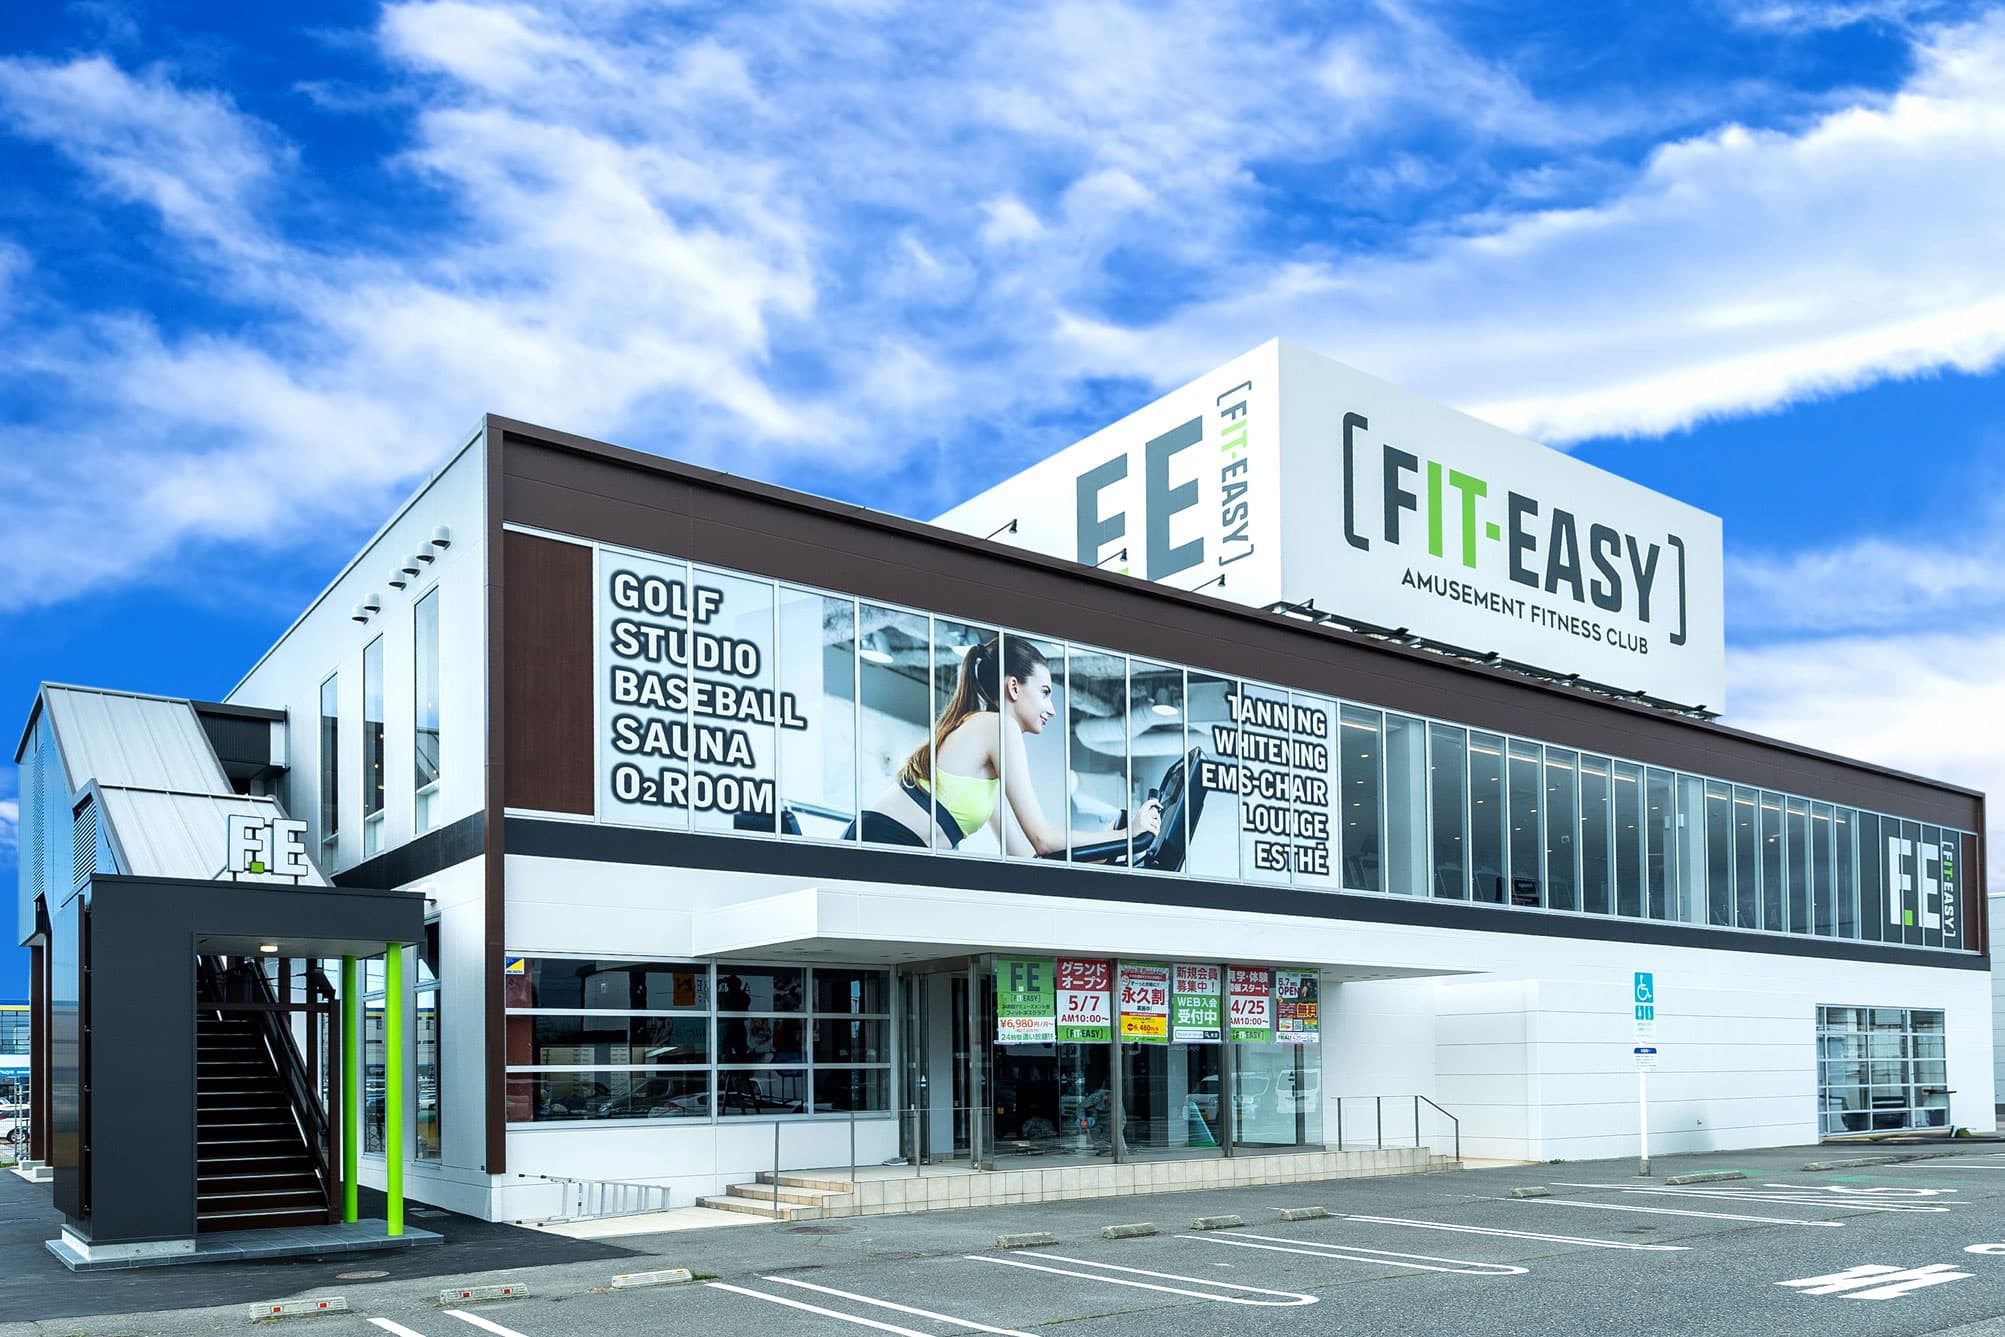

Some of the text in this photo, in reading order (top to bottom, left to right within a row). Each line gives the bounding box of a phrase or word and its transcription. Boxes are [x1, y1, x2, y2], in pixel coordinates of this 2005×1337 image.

[612, 570, 721, 622] GOLF
[1401, 568, 1650, 655] AMUSEMENT FITNESS CLUB
[612, 620, 759, 677] STUDIO
[612, 667, 806, 729] BASEBALL
[1226, 694, 1327, 738] TANNING
[613, 715, 754, 767] SAUNA
[1213, 726, 1327, 772] WHITENING
[1200, 761, 1328, 806] EMS-CHAIR
[1242, 803, 1328, 839] LOUNGE
[1061, 962, 1107, 976] グランド
[1061, 975, 1107, 989] オープン
[1176, 966, 1218, 981] 新規会員
[1068, 994, 1100, 1012] 5/7
[1121, 986, 1165, 1006] 永久割
[1177, 996, 1217, 1008] WEB入会
[1278, 986, 1301, 996] OPEN
[1177, 1008, 1217, 1025] 受付中
[1231, 999, 1265, 1015] 4/25
